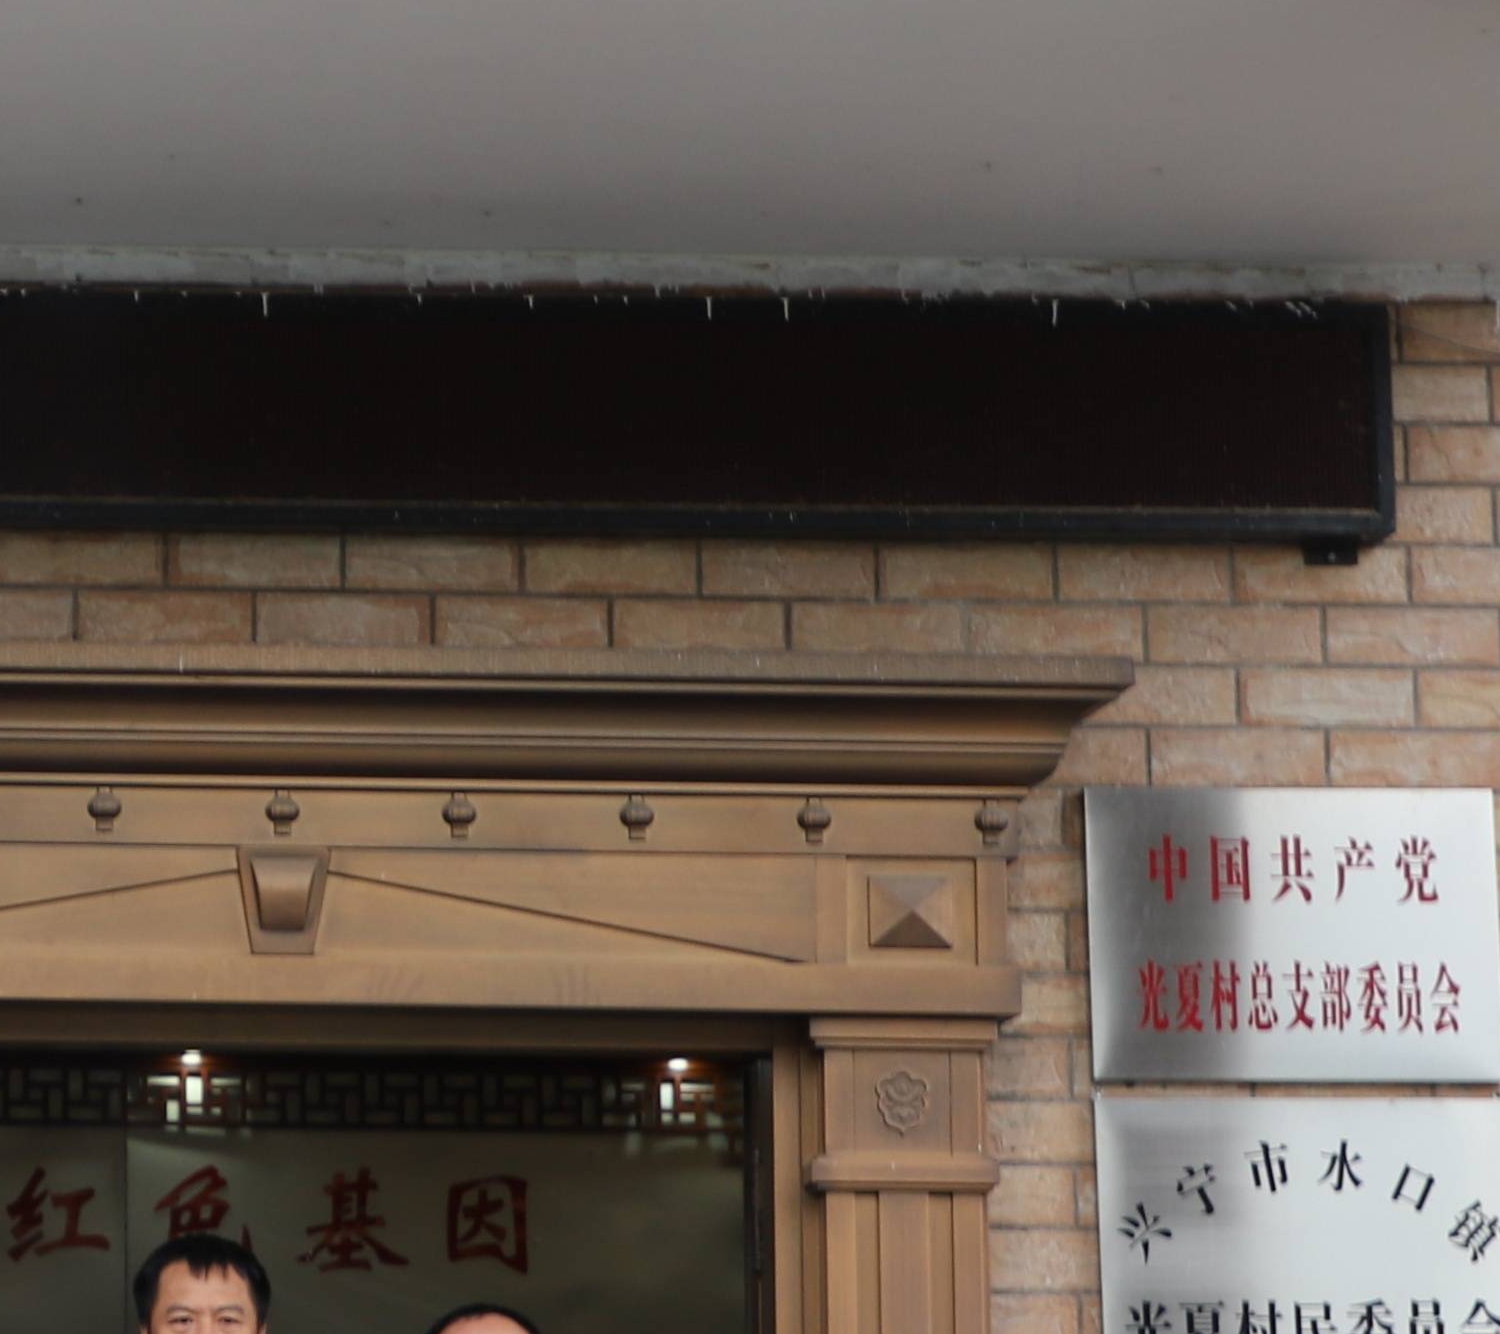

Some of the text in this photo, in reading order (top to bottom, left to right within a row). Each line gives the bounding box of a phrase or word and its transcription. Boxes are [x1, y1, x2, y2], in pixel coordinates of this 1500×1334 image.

[1148, 833, 1440, 904] 中国共产党
[1138, 959, 1461, 1035] 光夏村总支部委员会
